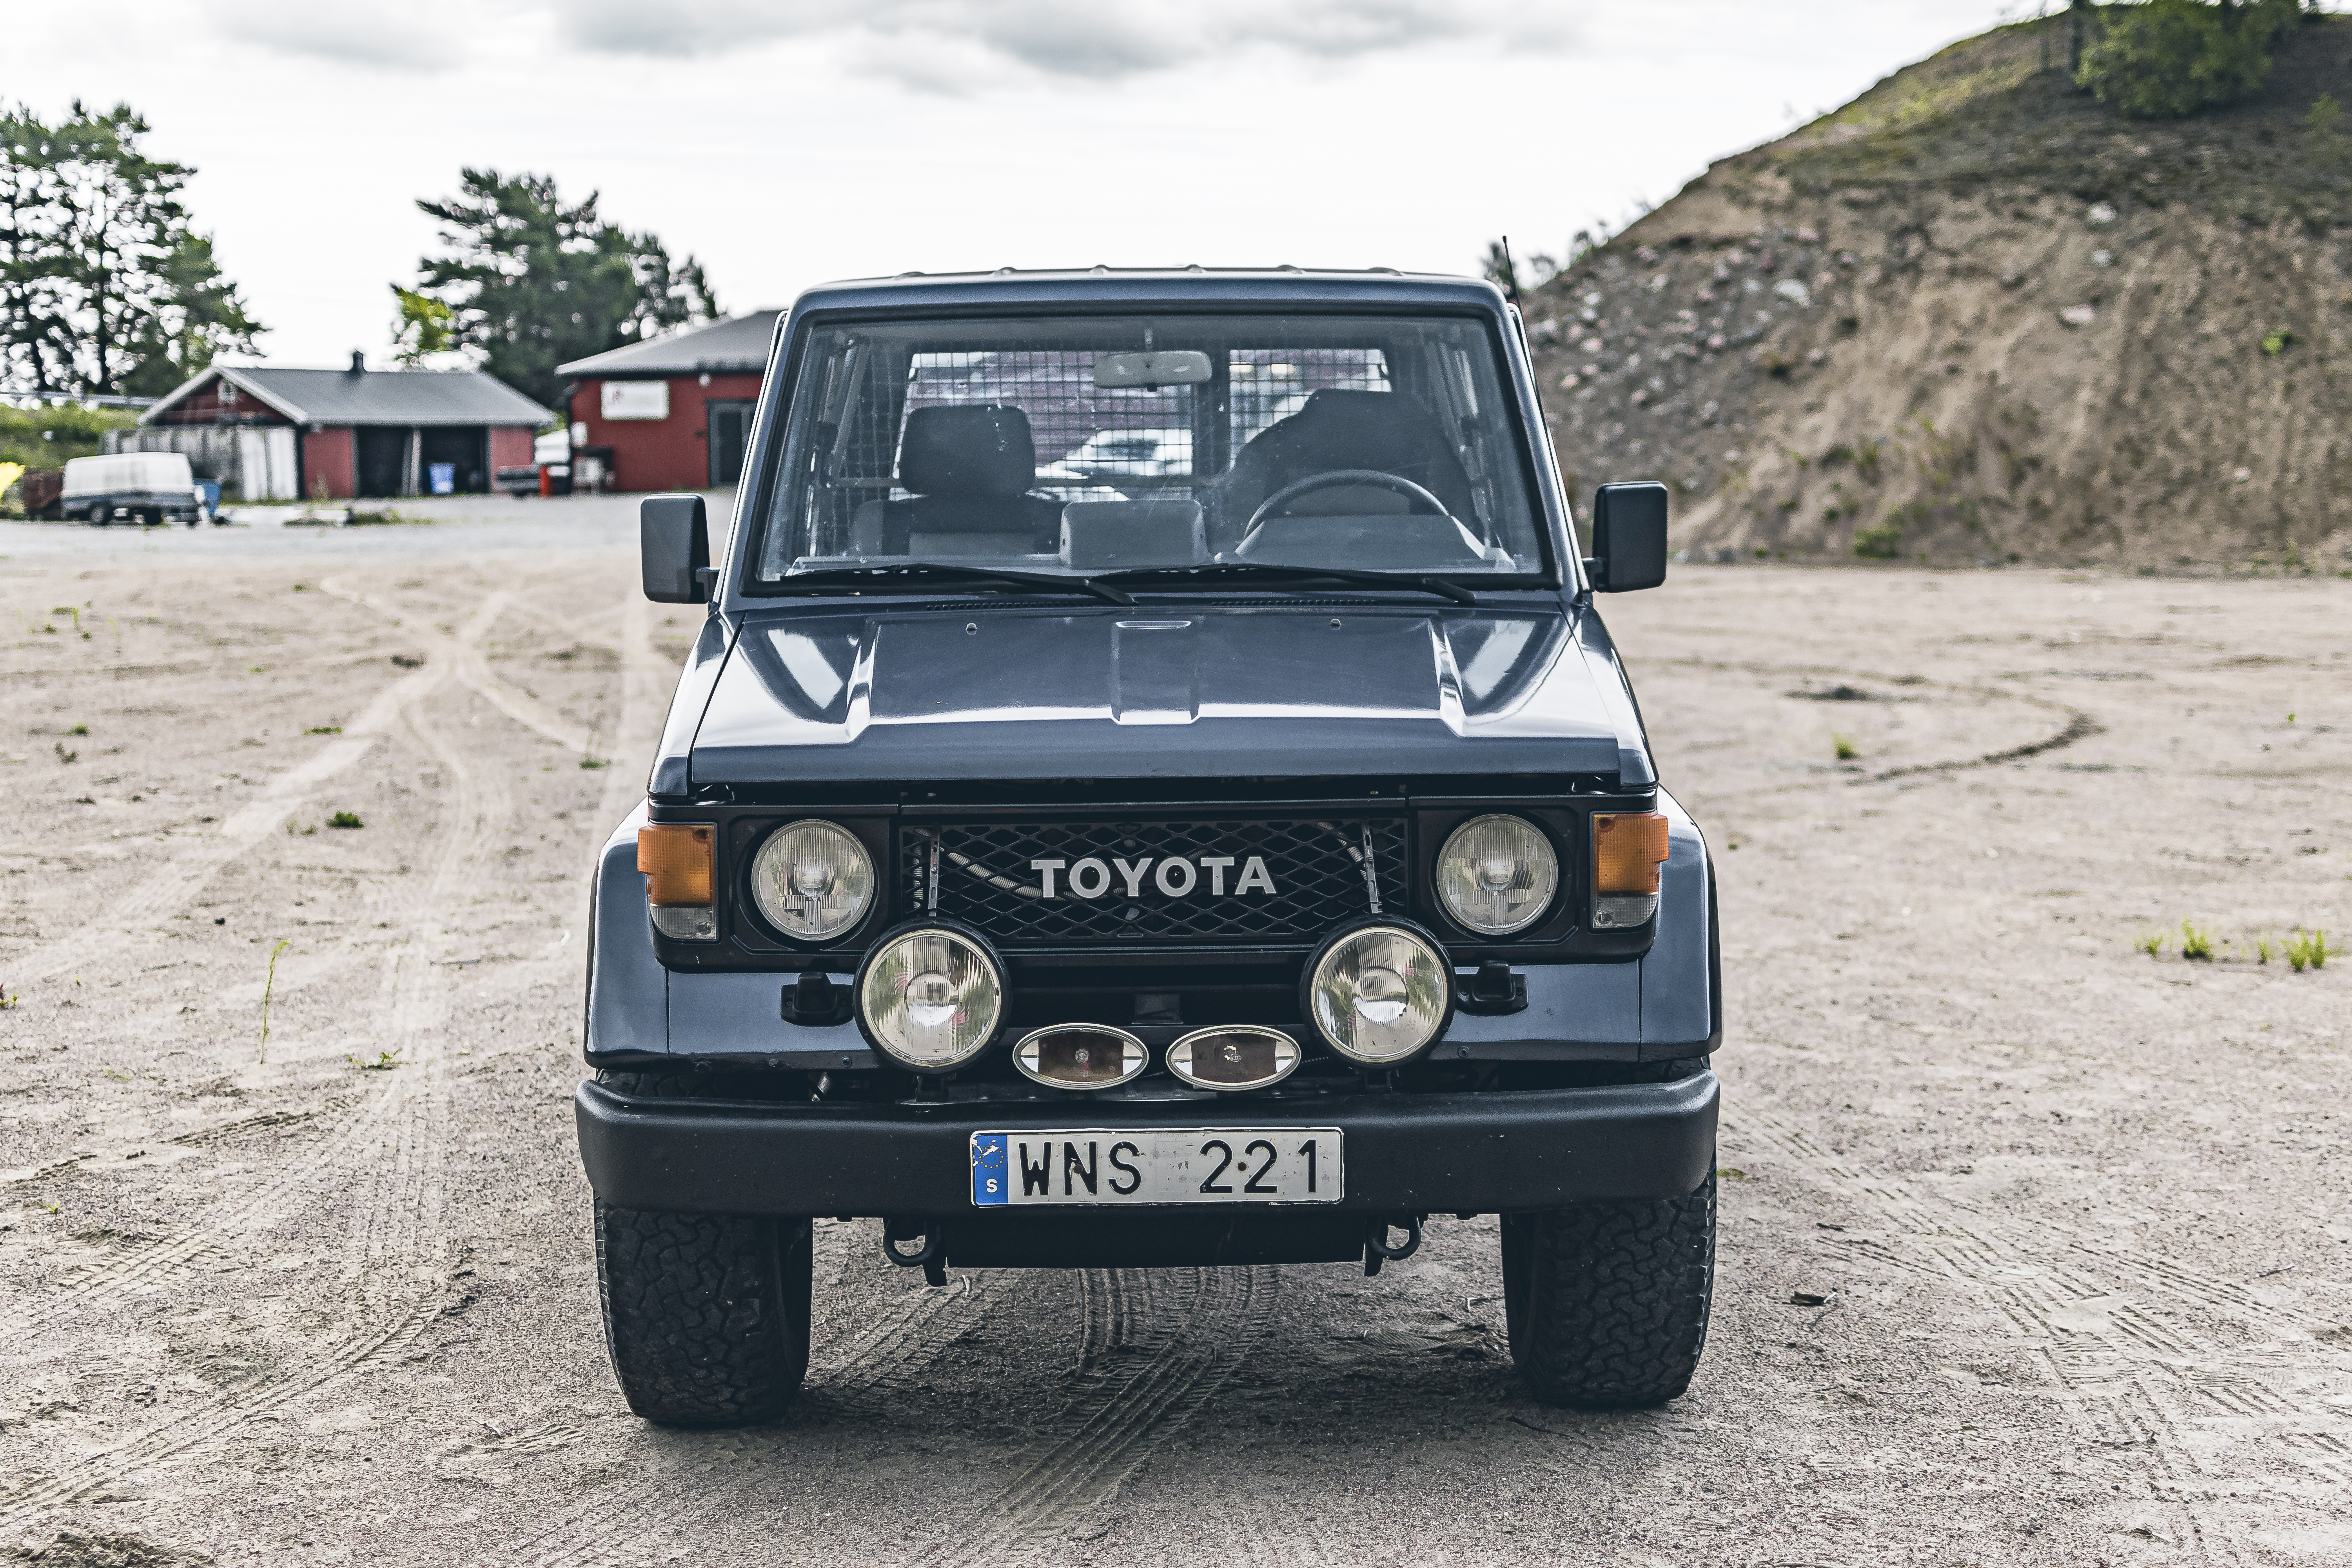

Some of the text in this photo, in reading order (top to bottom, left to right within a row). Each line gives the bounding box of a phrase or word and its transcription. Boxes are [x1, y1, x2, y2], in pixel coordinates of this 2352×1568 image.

[1031, 856, 1277, 898] TOYOTA
[986, 1178, 998, 1193] S
[1018, 1138, 1316, 1196] WNS 221
